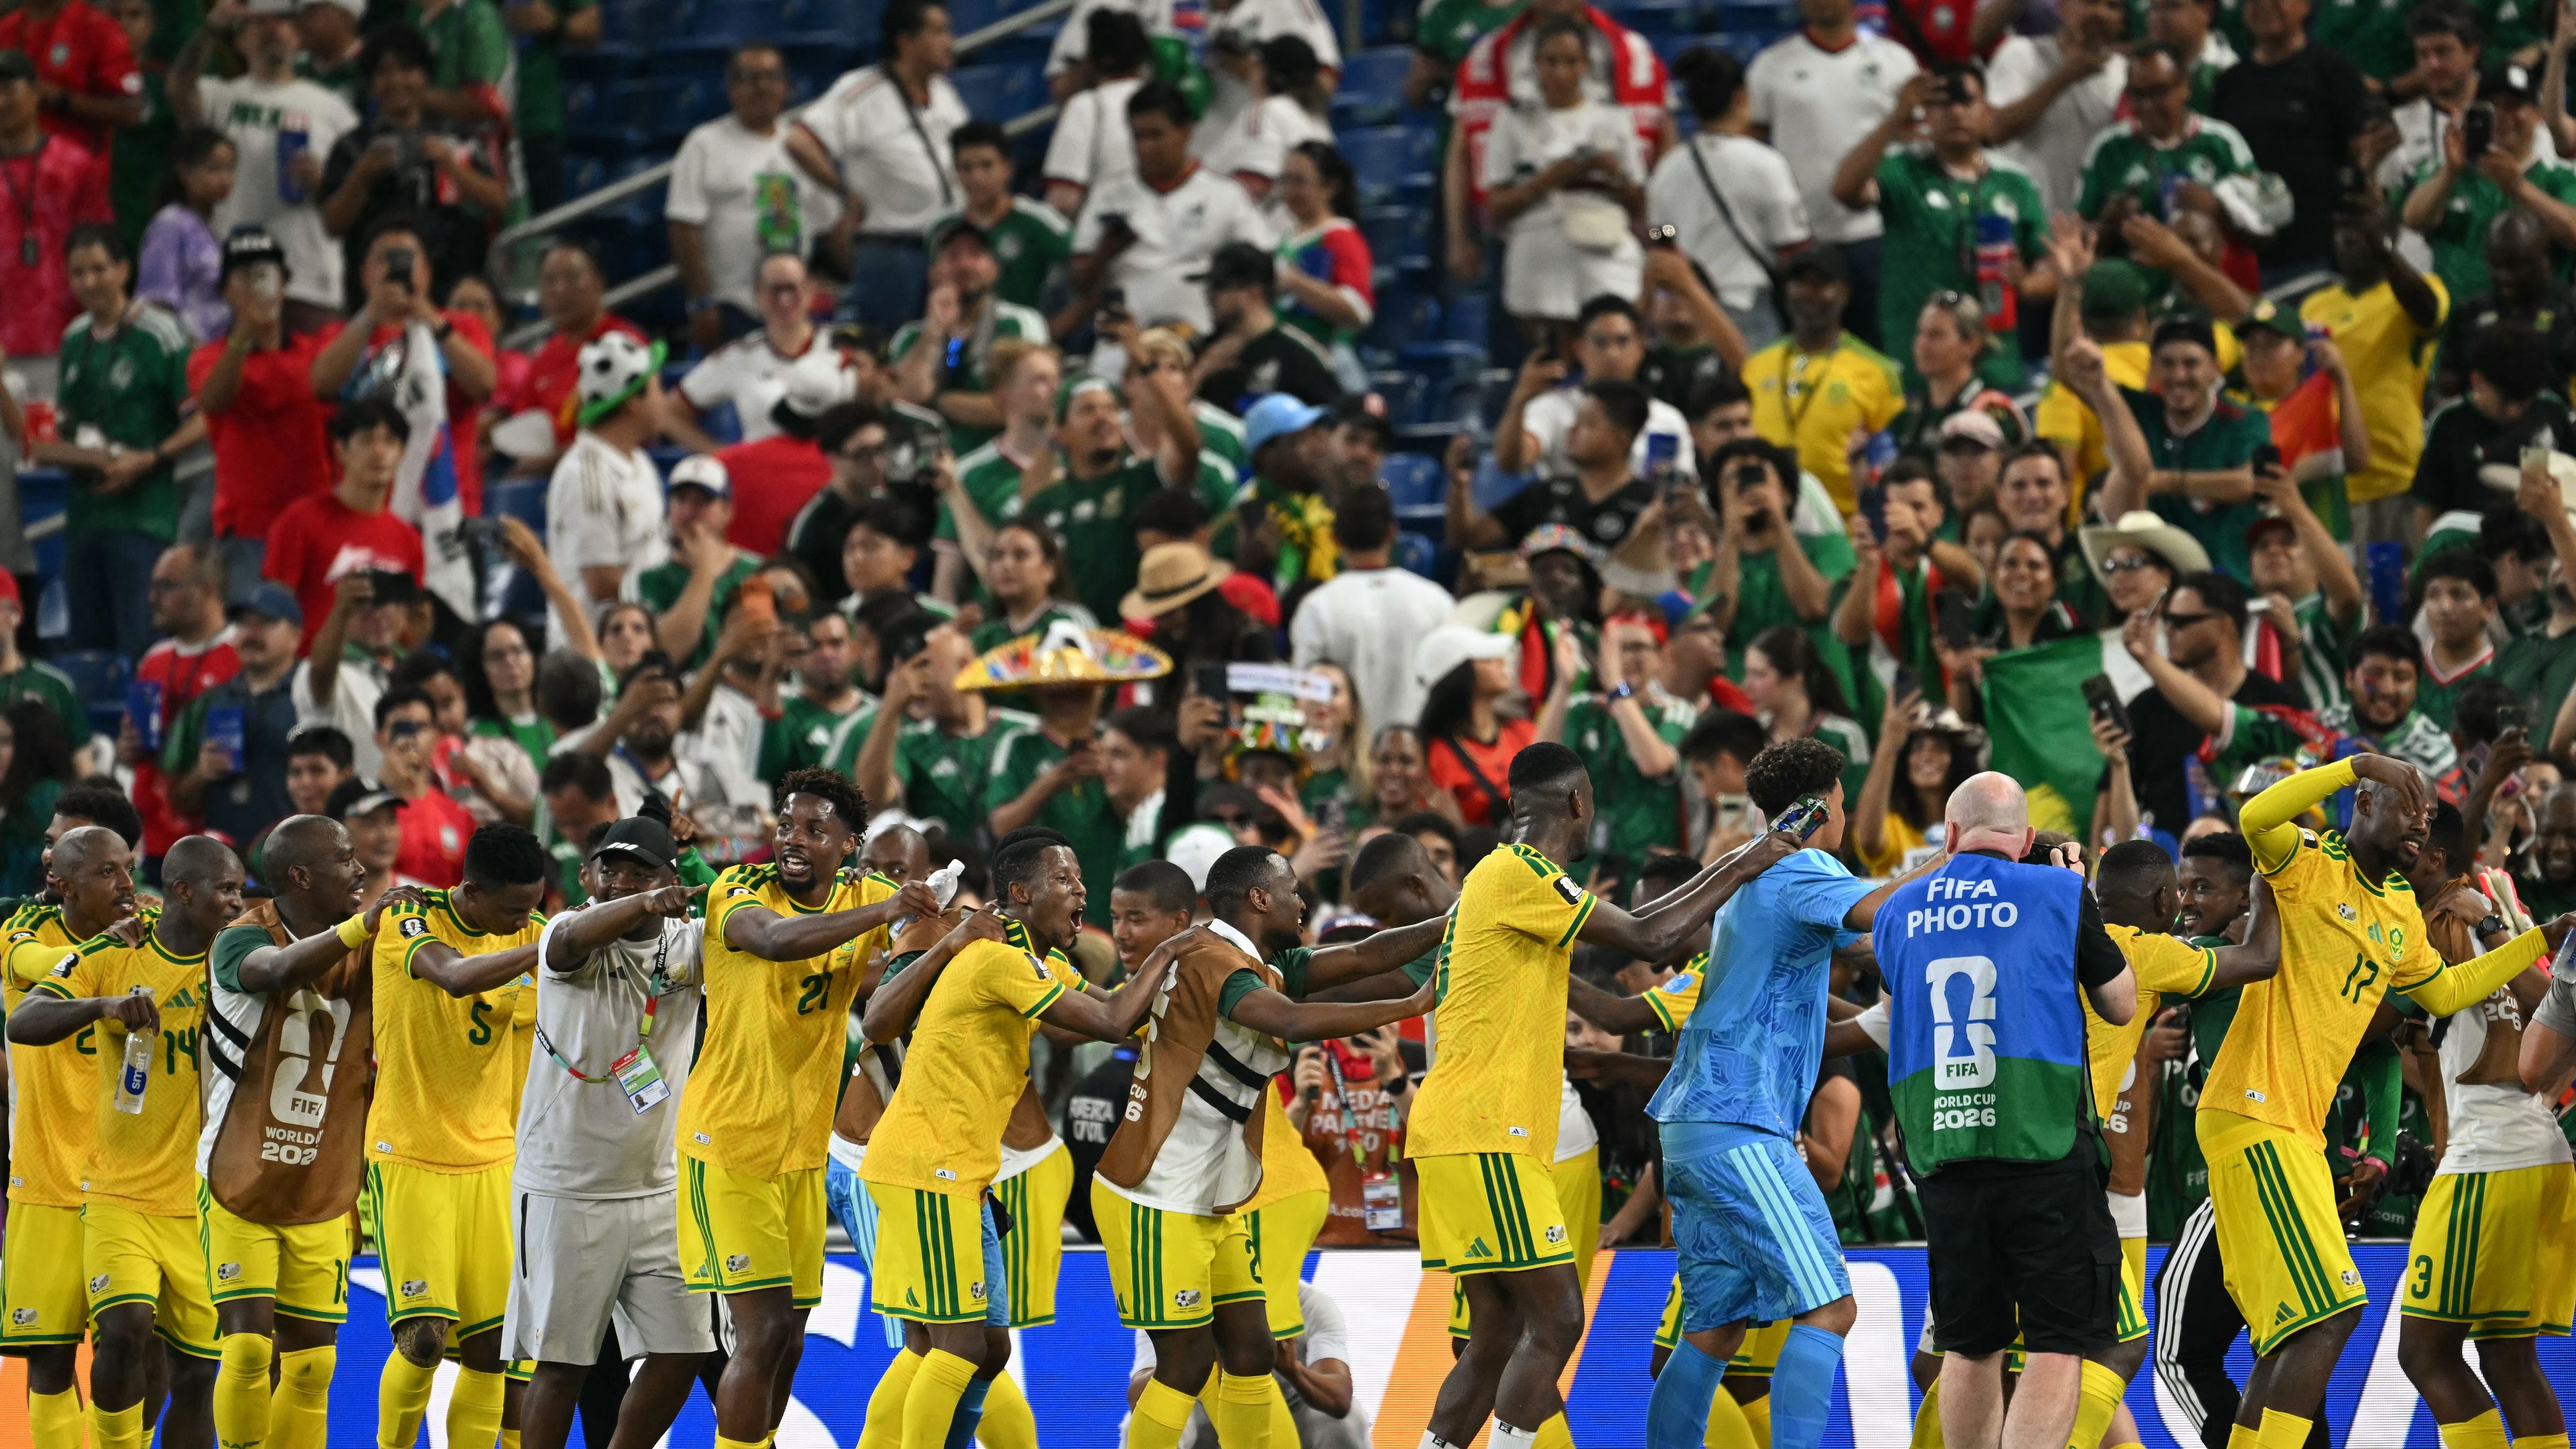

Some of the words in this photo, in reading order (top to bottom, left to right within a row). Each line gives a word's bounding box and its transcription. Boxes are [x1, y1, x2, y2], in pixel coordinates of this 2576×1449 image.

[1927, 877, 1998, 902] FIFA
[1908, 902, 2018, 938] PHOTO
[2341, 952, 2379, 1004] 17
[797, 971, 833, 1016] 21
[469, 1001, 493, 1045] 5
[164, 1025, 198, 1075] 14
[131, 1052, 147, 1090] smart
[1946, 1062, 1979, 1077] FIFA
[1130, 1084, 1147, 1101] CUP
[1973, 1094, 1996, 1106] CUP
[1934, 1108, 1996, 1131] 2026
[265, 1126, 315, 1144] WORLD
[261, 1142, 318, 1165] 202
[2411, 1255, 2433, 1300] 3
